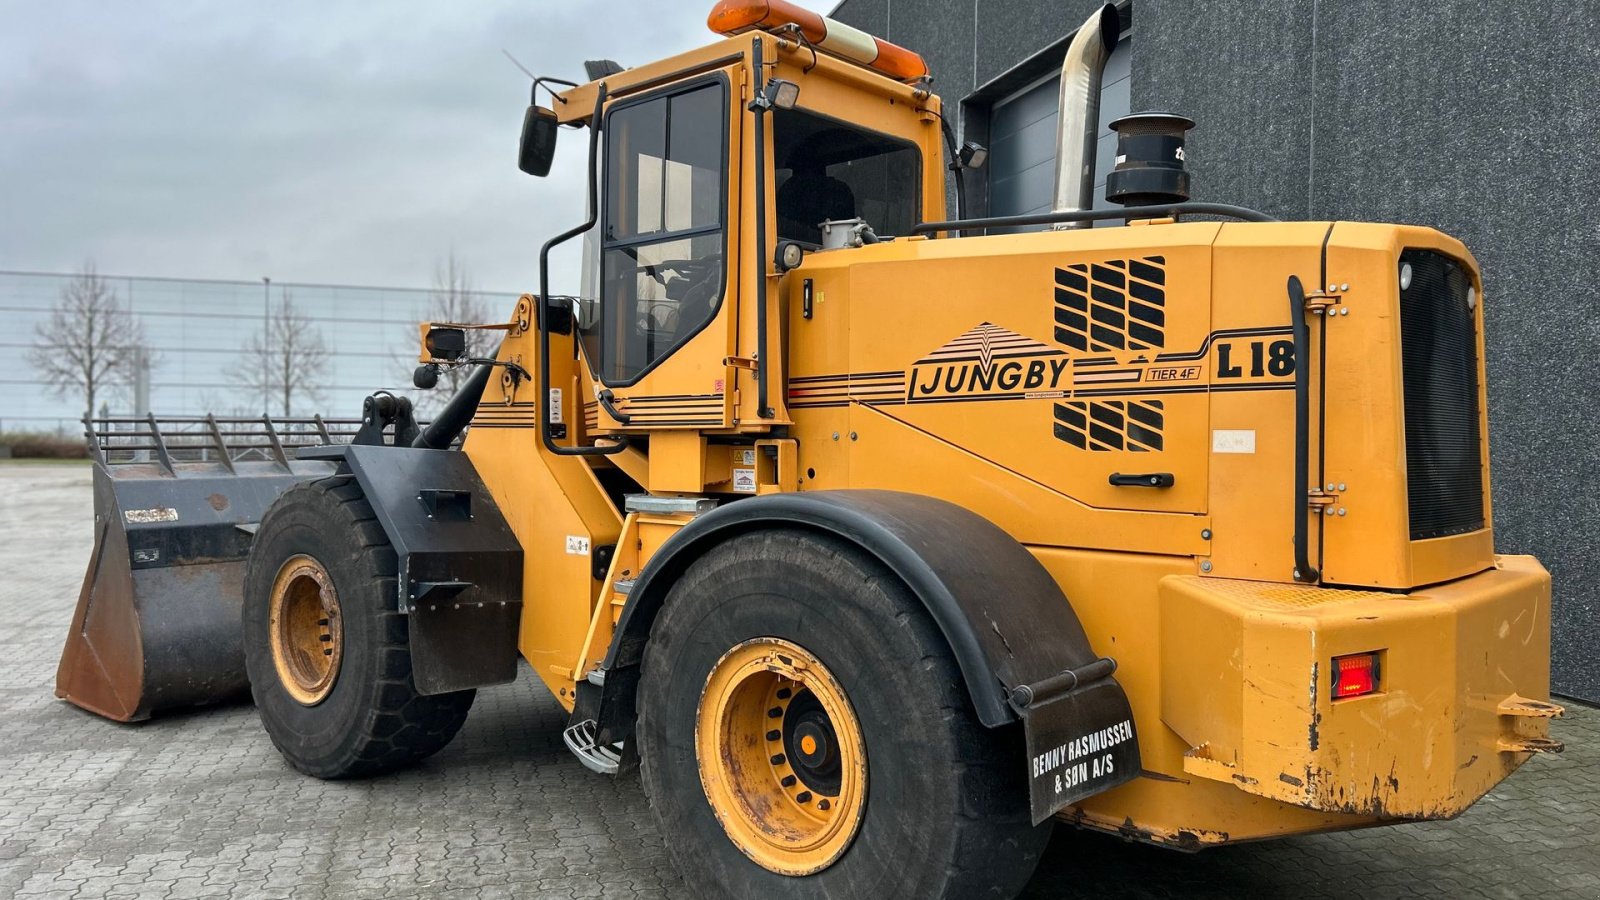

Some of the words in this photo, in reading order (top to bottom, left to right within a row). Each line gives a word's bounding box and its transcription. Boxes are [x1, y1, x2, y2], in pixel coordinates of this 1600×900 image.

[1152, 369, 1177, 380] TIER
[1180, 368, 1195, 379] 4F
[1033, 744, 1067, 778] BENNY
[1068, 719, 1133, 762] RASMUSSEN
[1054, 774, 1062, 794] &
[1065, 762, 1088, 789] SØN
[1092, 753, 1114, 779] A/S
